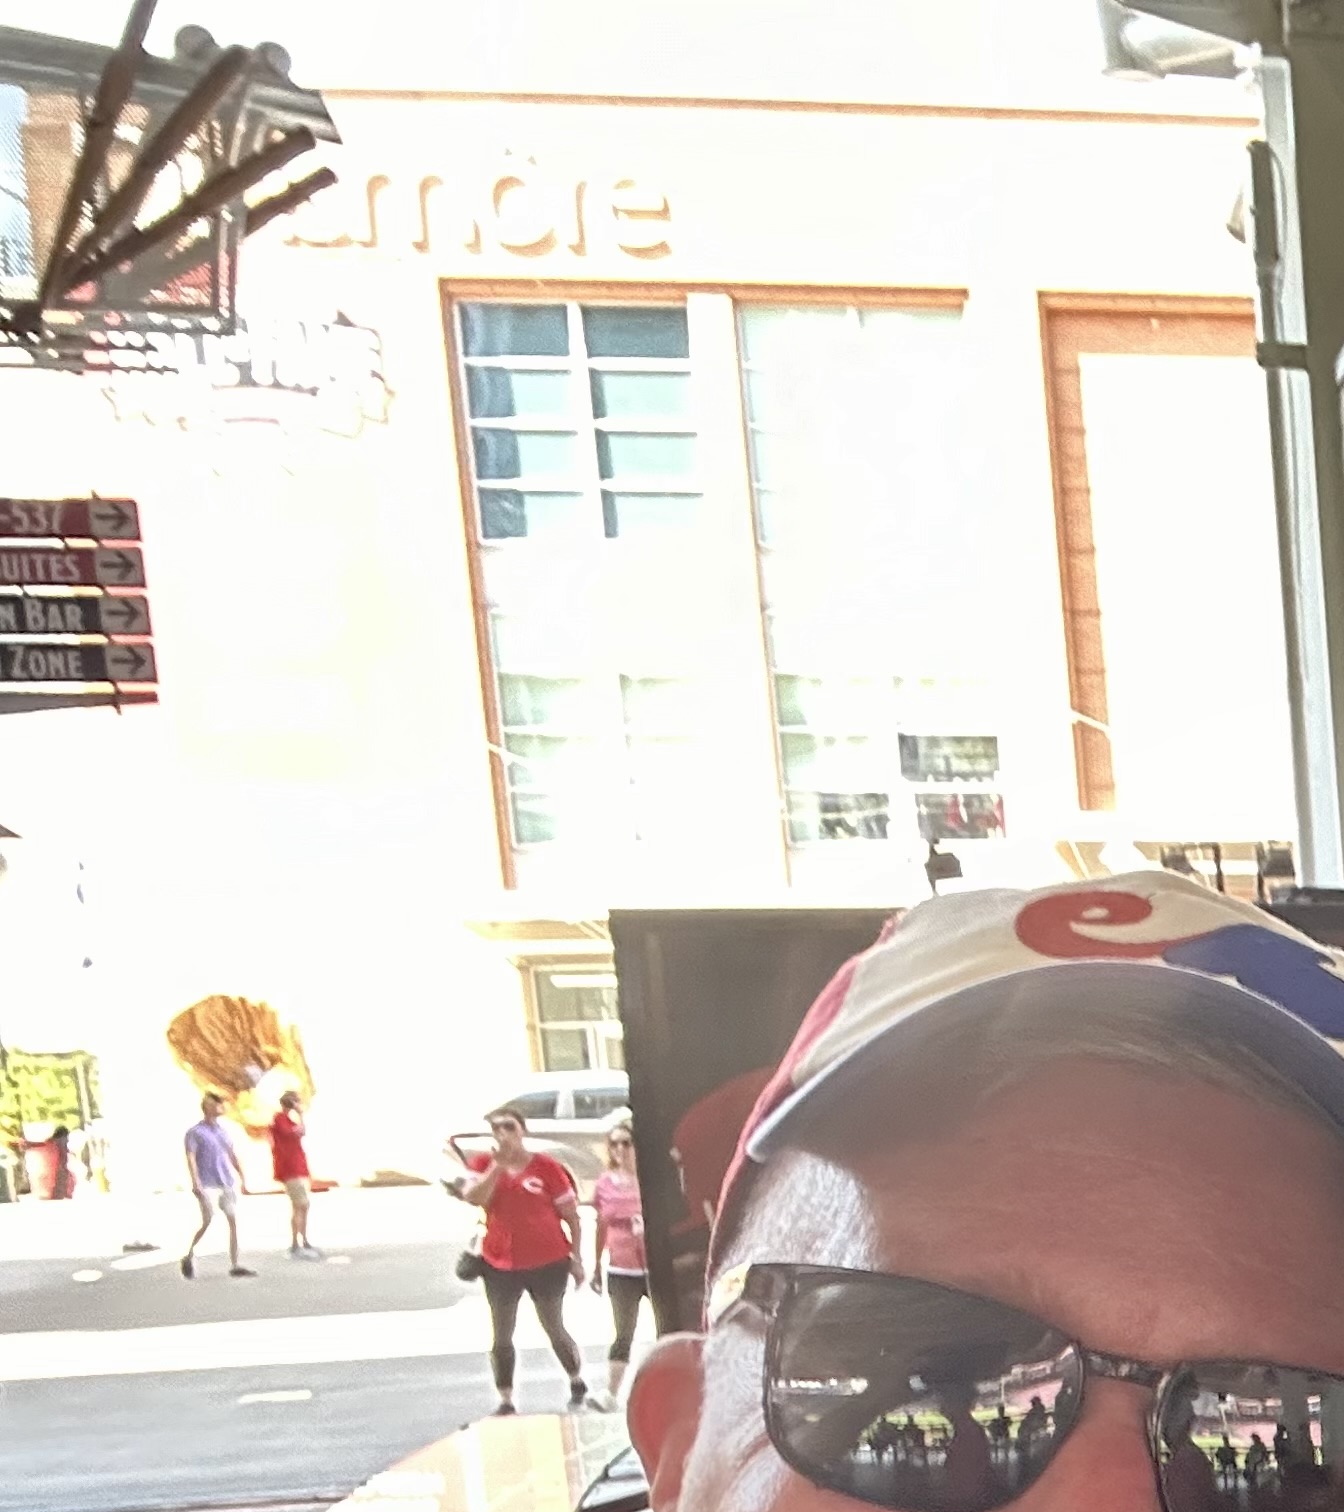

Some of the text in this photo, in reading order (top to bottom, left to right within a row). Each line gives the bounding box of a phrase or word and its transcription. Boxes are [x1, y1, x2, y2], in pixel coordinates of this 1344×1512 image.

[0, 552, 81, 581] UITES
[23, 598, 86, 632] BAR
[7, 646, 85, 680] ZONE
